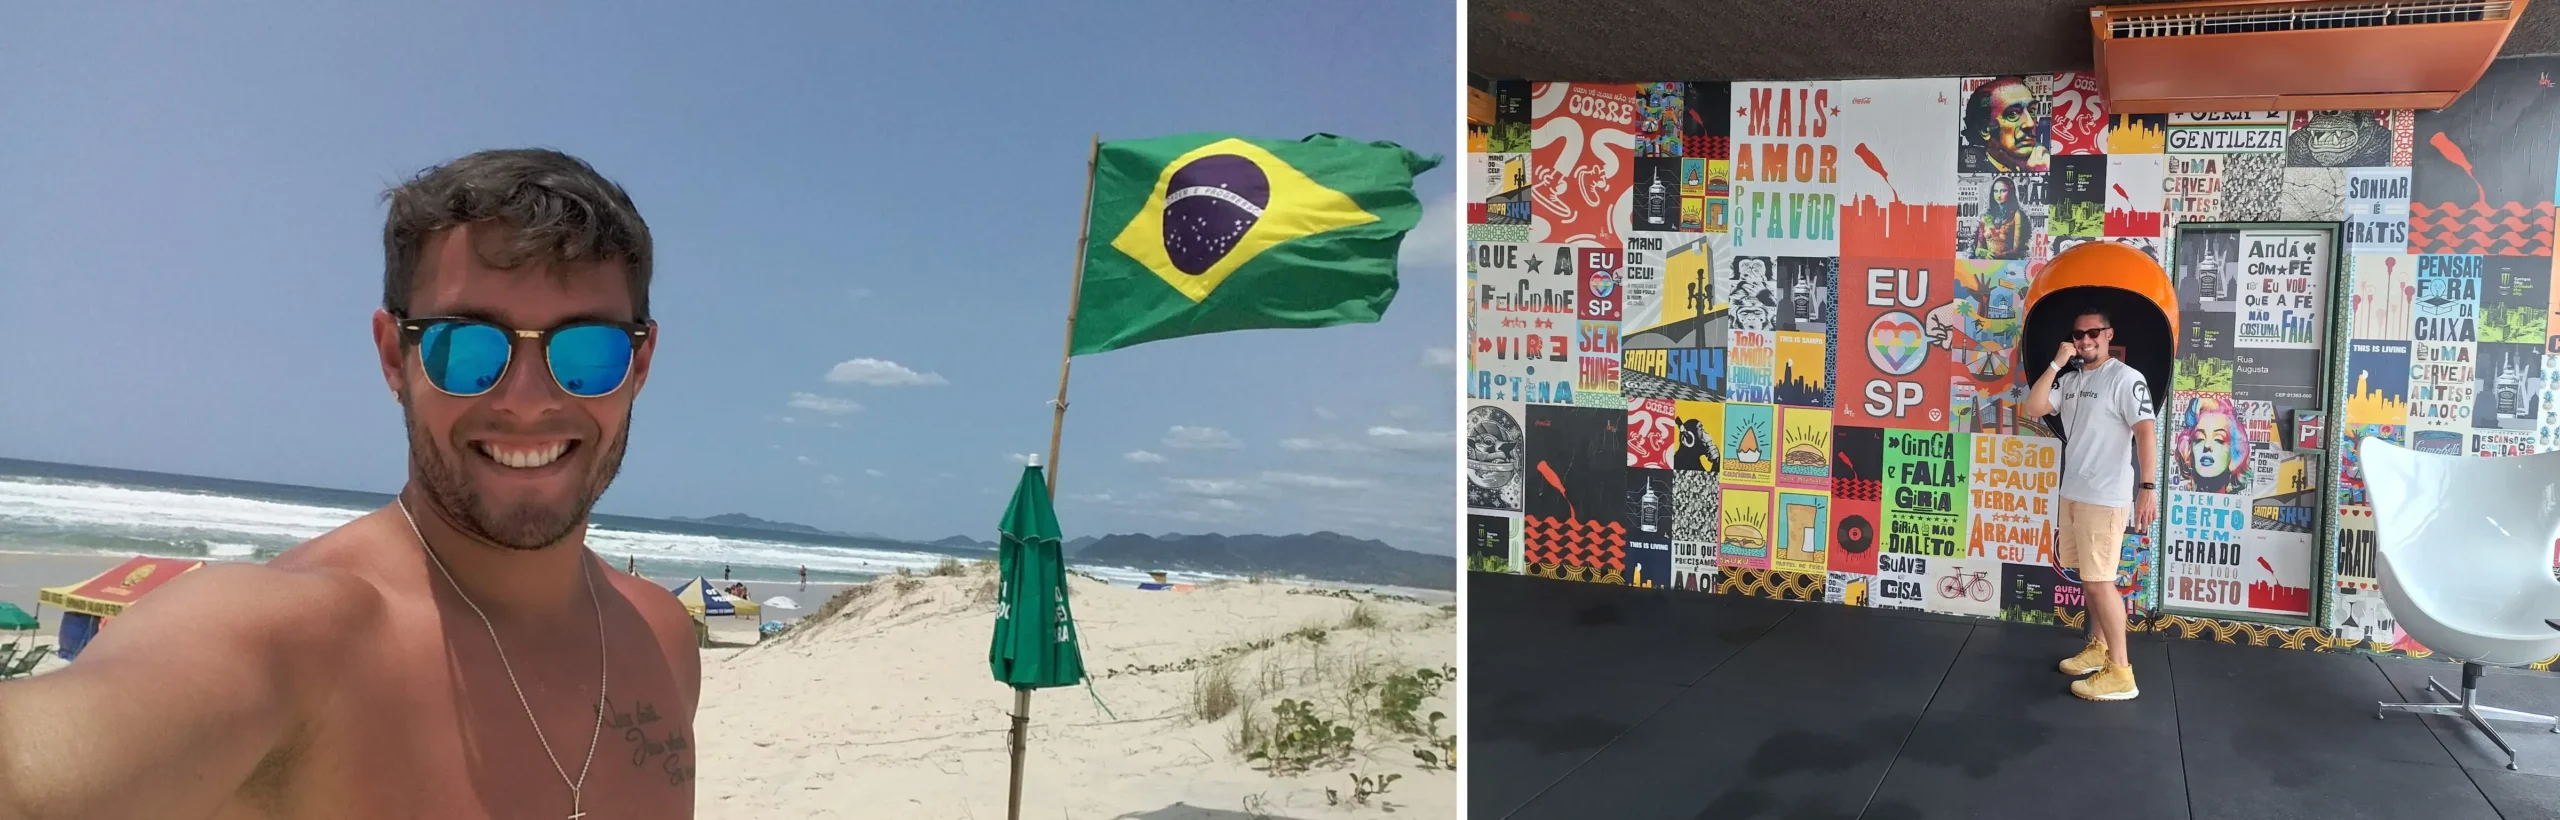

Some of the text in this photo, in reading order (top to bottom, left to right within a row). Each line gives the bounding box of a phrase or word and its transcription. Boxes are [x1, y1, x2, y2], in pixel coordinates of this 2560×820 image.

[1569, 94, 1634, 125] CORRE
[1748, 88, 1828, 137] MAIS
[2170, 130, 2283, 149] GENTILEZA
[1735, 144, 1838, 183] AMOR
[2162, 176, 2221, 197] CERVEJA
[2349, 176, 2409, 200] SONHAR
[1956, 203, 1979, 217] AQUI
[2163, 197, 2211, 213] ANTES
[2373, 201, 2381, 215] É
[1733, 185, 1745, 247] POR
[1751, 192, 1836, 241] FAVOR
[1628, 237, 1663, 251] MANO
[1479, 245, 1573, 275] QUE A
[1589, 252, 1614, 269] EU
[1627, 252, 1643, 265] DO
[2248, 256, 2312, 276] COM FÉ
[2418, 255, 2483, 279] PENSAR
[1867, 267, 1929, 308] EU
[2286, 277, 2307, 293] VOU
[1481, 279, 1575, 314] FELICIDADE
[2276, 294, 2287, 306] A
[2294, 292, 2313, 308] FÉ
[1588, 299, 1612, 316] SP
[2248, 309, 2270, 321] NÃO
[2459, 303, 2474, 318] DA
[1579, 321, 1618, 354] SER
[2240, 322, 2280, 336] COSTUMA
[2414, 316, 2476, 343] CAIXA
[1496, 333, 1568, 362] VIRE
[1779, 335, 1793, 343] THIS
[1801, 336, 1823, 345] SAMPA
[2353, 344, 2407, 354] THIS IS LIVING
[1731, 347, 1773, 367] AMOR
[2237, 355, 2254, 363] Rua
[1733, 366, 1772, 387] HOUVER
[2236, 365, 2269, 374] Augusta
[2410, 364, 2474, 385] CERVEJA
[1735, 385, 1772, 404] VIDA
[1863, 379, 1924, 418] SP
[2411, 385, 2463, 402] ANTES
[1645, 401, 1675, 416] CORRE
[2409, 400, 2471, 421] ALMOÇO
[2258, 452, 2279, 460] MANO
[1901, 460, 1956, 488] FALA
[1989, 468, 2058, 494] PAULO
[1971, 489, 2049, 515] TERRA DE
[2189, 494, 2230, 507] TEM O
[2171, 504, 2245, 531] CERTO
[1932, 522, 1955, 536] NÃO
[1967, 513, 2054, 564] ARRANHA
[2185, 527, 2230, 542] TEM
[1650, 542, 1669, 551] LIVING
[1674, 543, 1717, 558] TUDO QUE
[1889, 533, 1955, 557] DIALETO
[2174, 539, 2241, 566] ERRADO
[1675, 558, 1717, 568] PRECISAMOS
[2170, 563, 2239, 579] E TEM TODO
[2054, 585, 2081, 594] QUEM
[2168, 576, 2241, 605] O RESTO
[2054, 592, 2085, 607] DIVI
